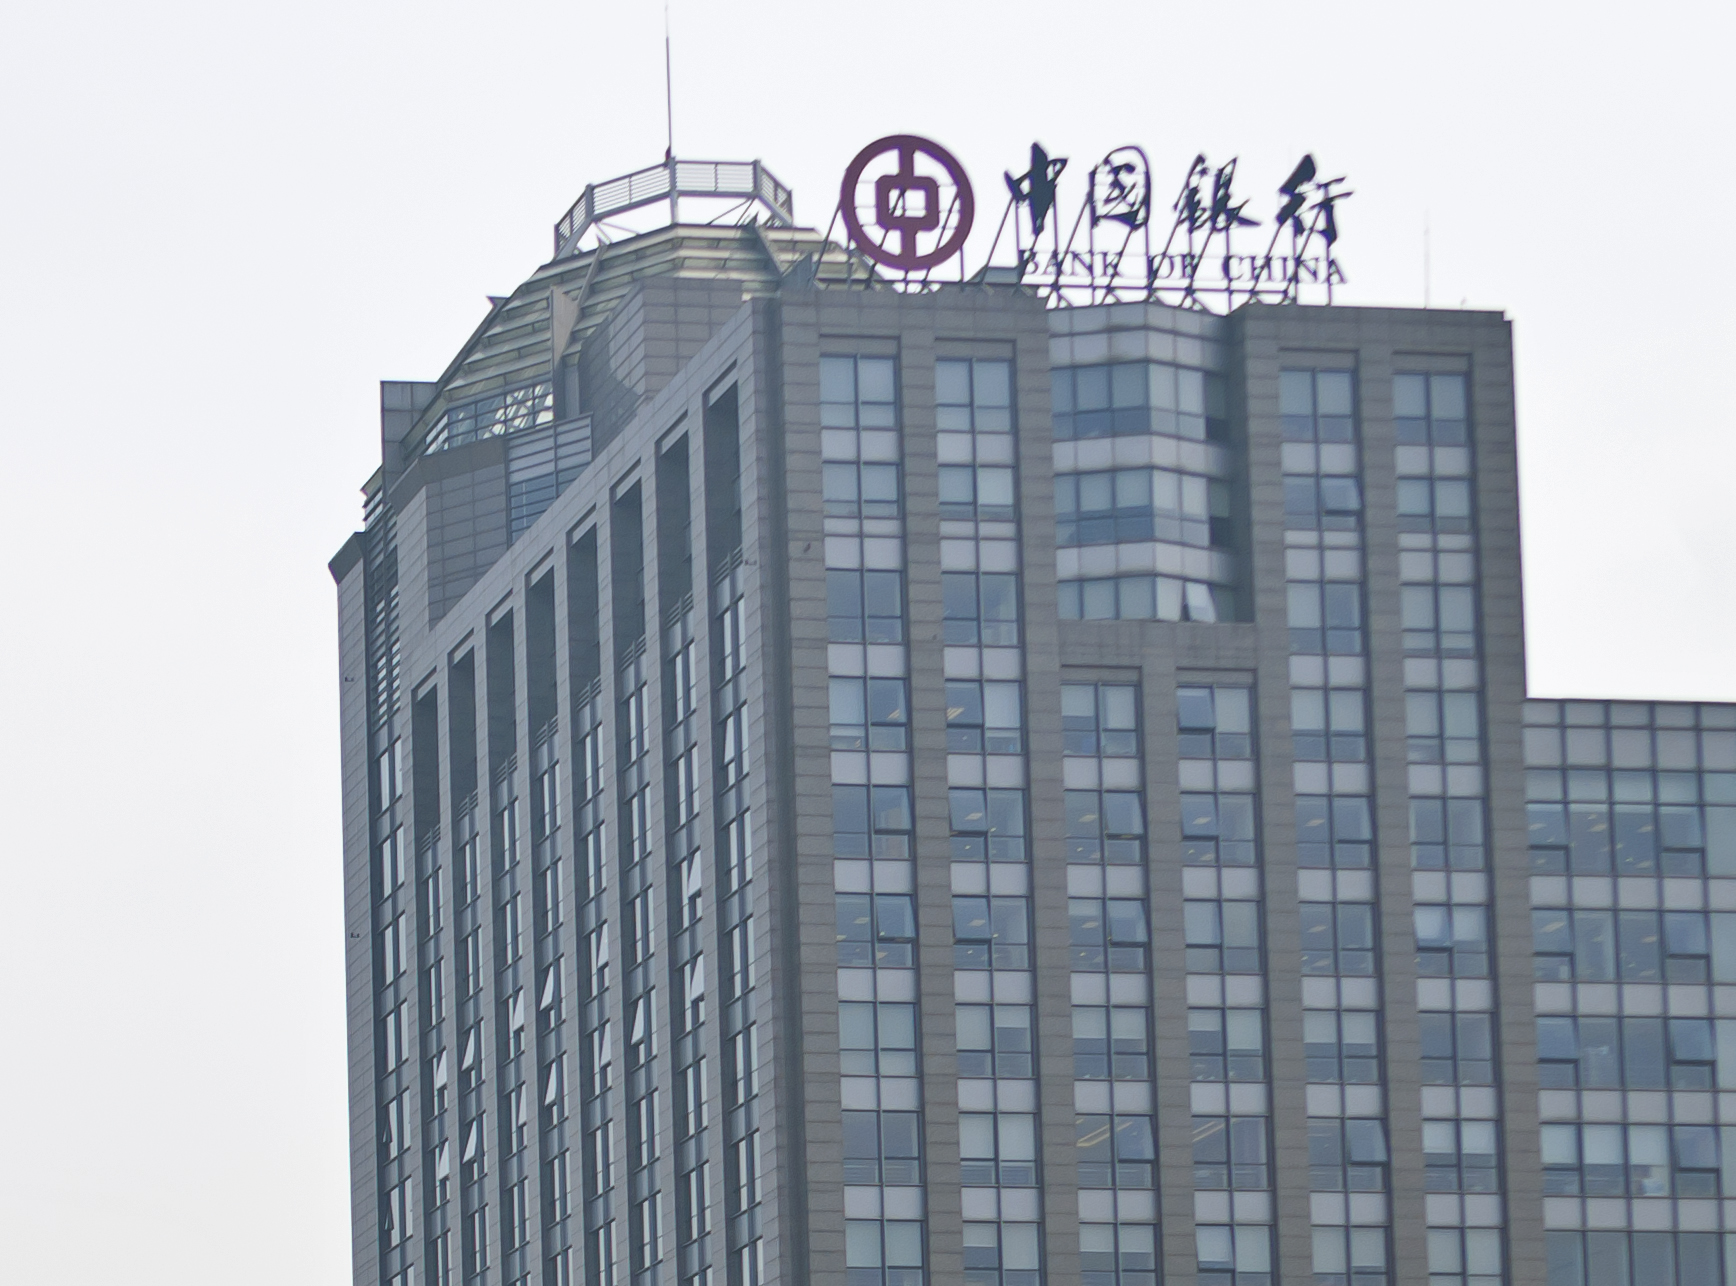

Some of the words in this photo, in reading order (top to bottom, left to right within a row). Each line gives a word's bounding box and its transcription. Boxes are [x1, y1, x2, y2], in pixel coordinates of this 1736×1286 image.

[1020, 249, 1122, 278] BANK
[1147, 253, 1198, 280] OF
[1221, 254, 1349, 285] CHINA
